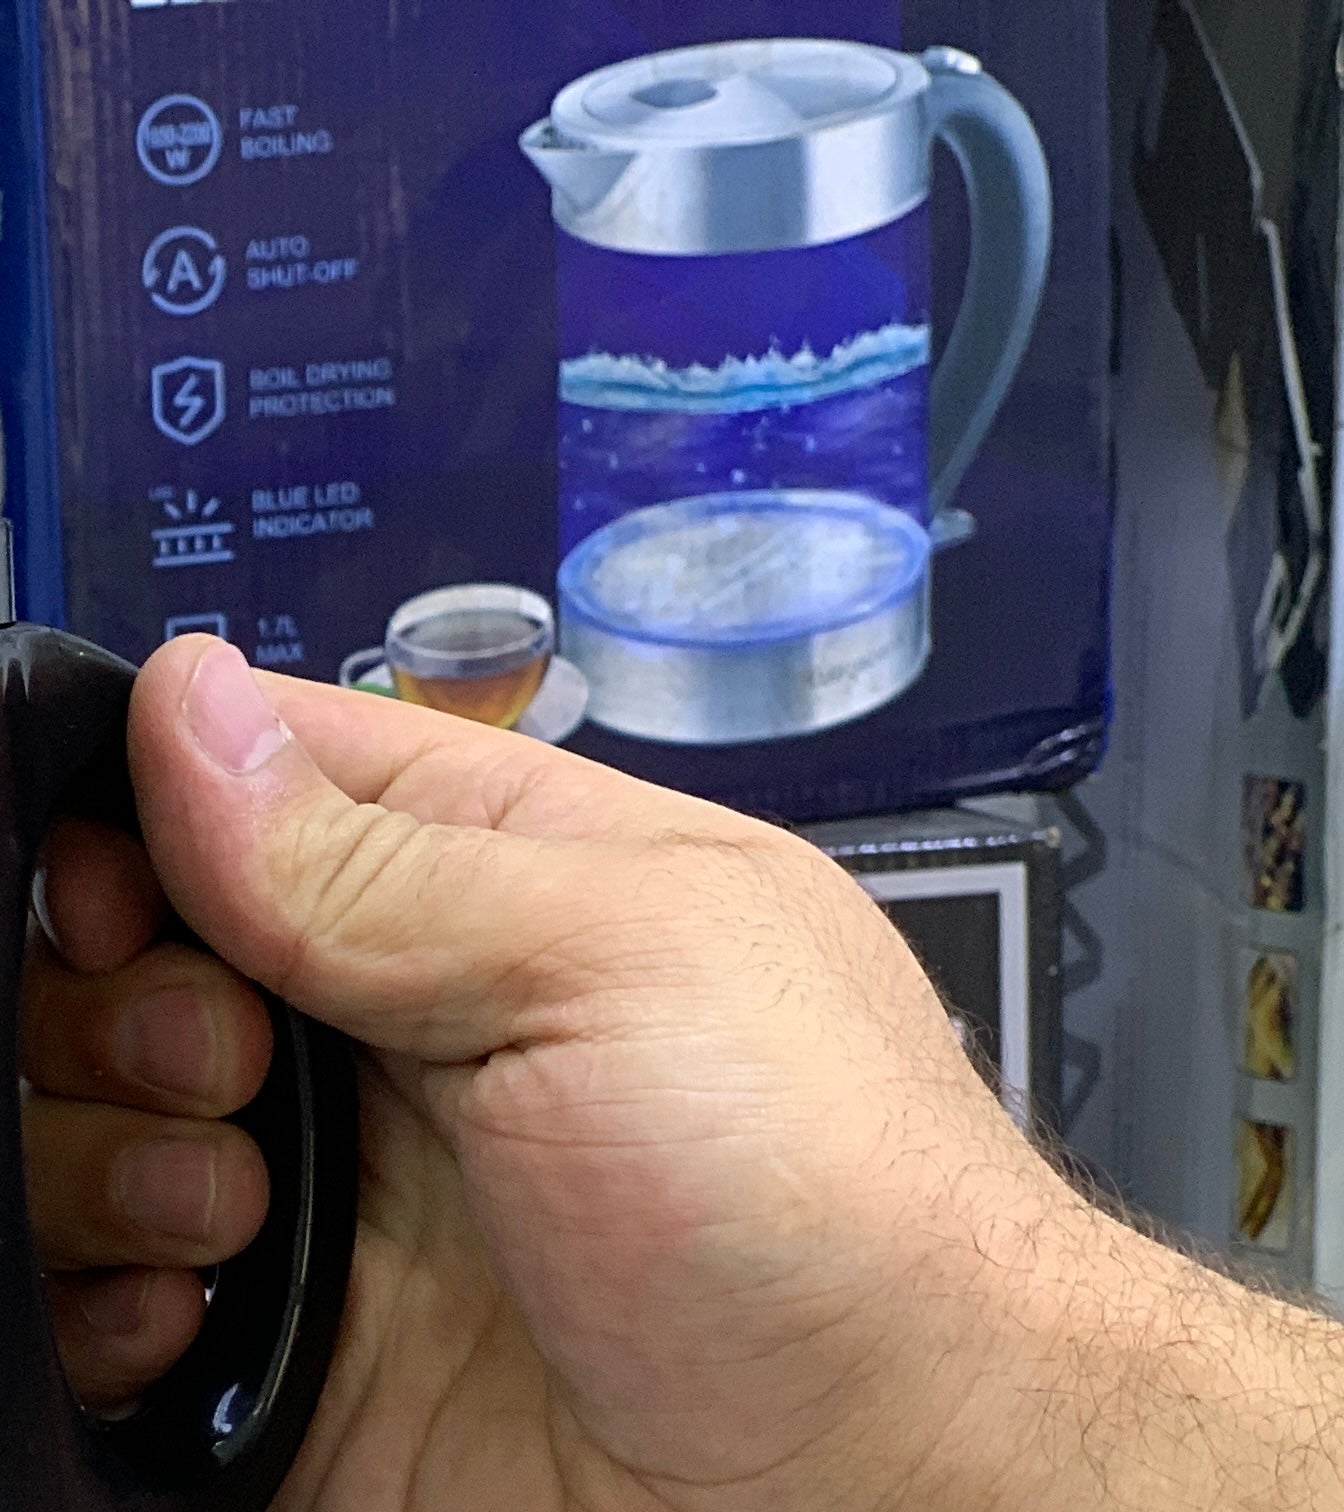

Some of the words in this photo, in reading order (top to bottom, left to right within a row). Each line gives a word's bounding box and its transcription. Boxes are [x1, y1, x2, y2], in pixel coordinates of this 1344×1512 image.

[240, 104, 299, 128] FAST
[241, 129, 334, 160] BOILING
[245, 235, 309, 262] AUTO
[246, 257, 359, 290] SHUT-OFF
[249, 366, 301, 391] BOIL
[306, 358, 392, 387] DRYING
[249, 387, 396, 419] PROTECTION
[251, 486, 309, 513] BLUE
[313, 481, 360, 505] LED
[253, 506, 374, 539] INDICATOR
